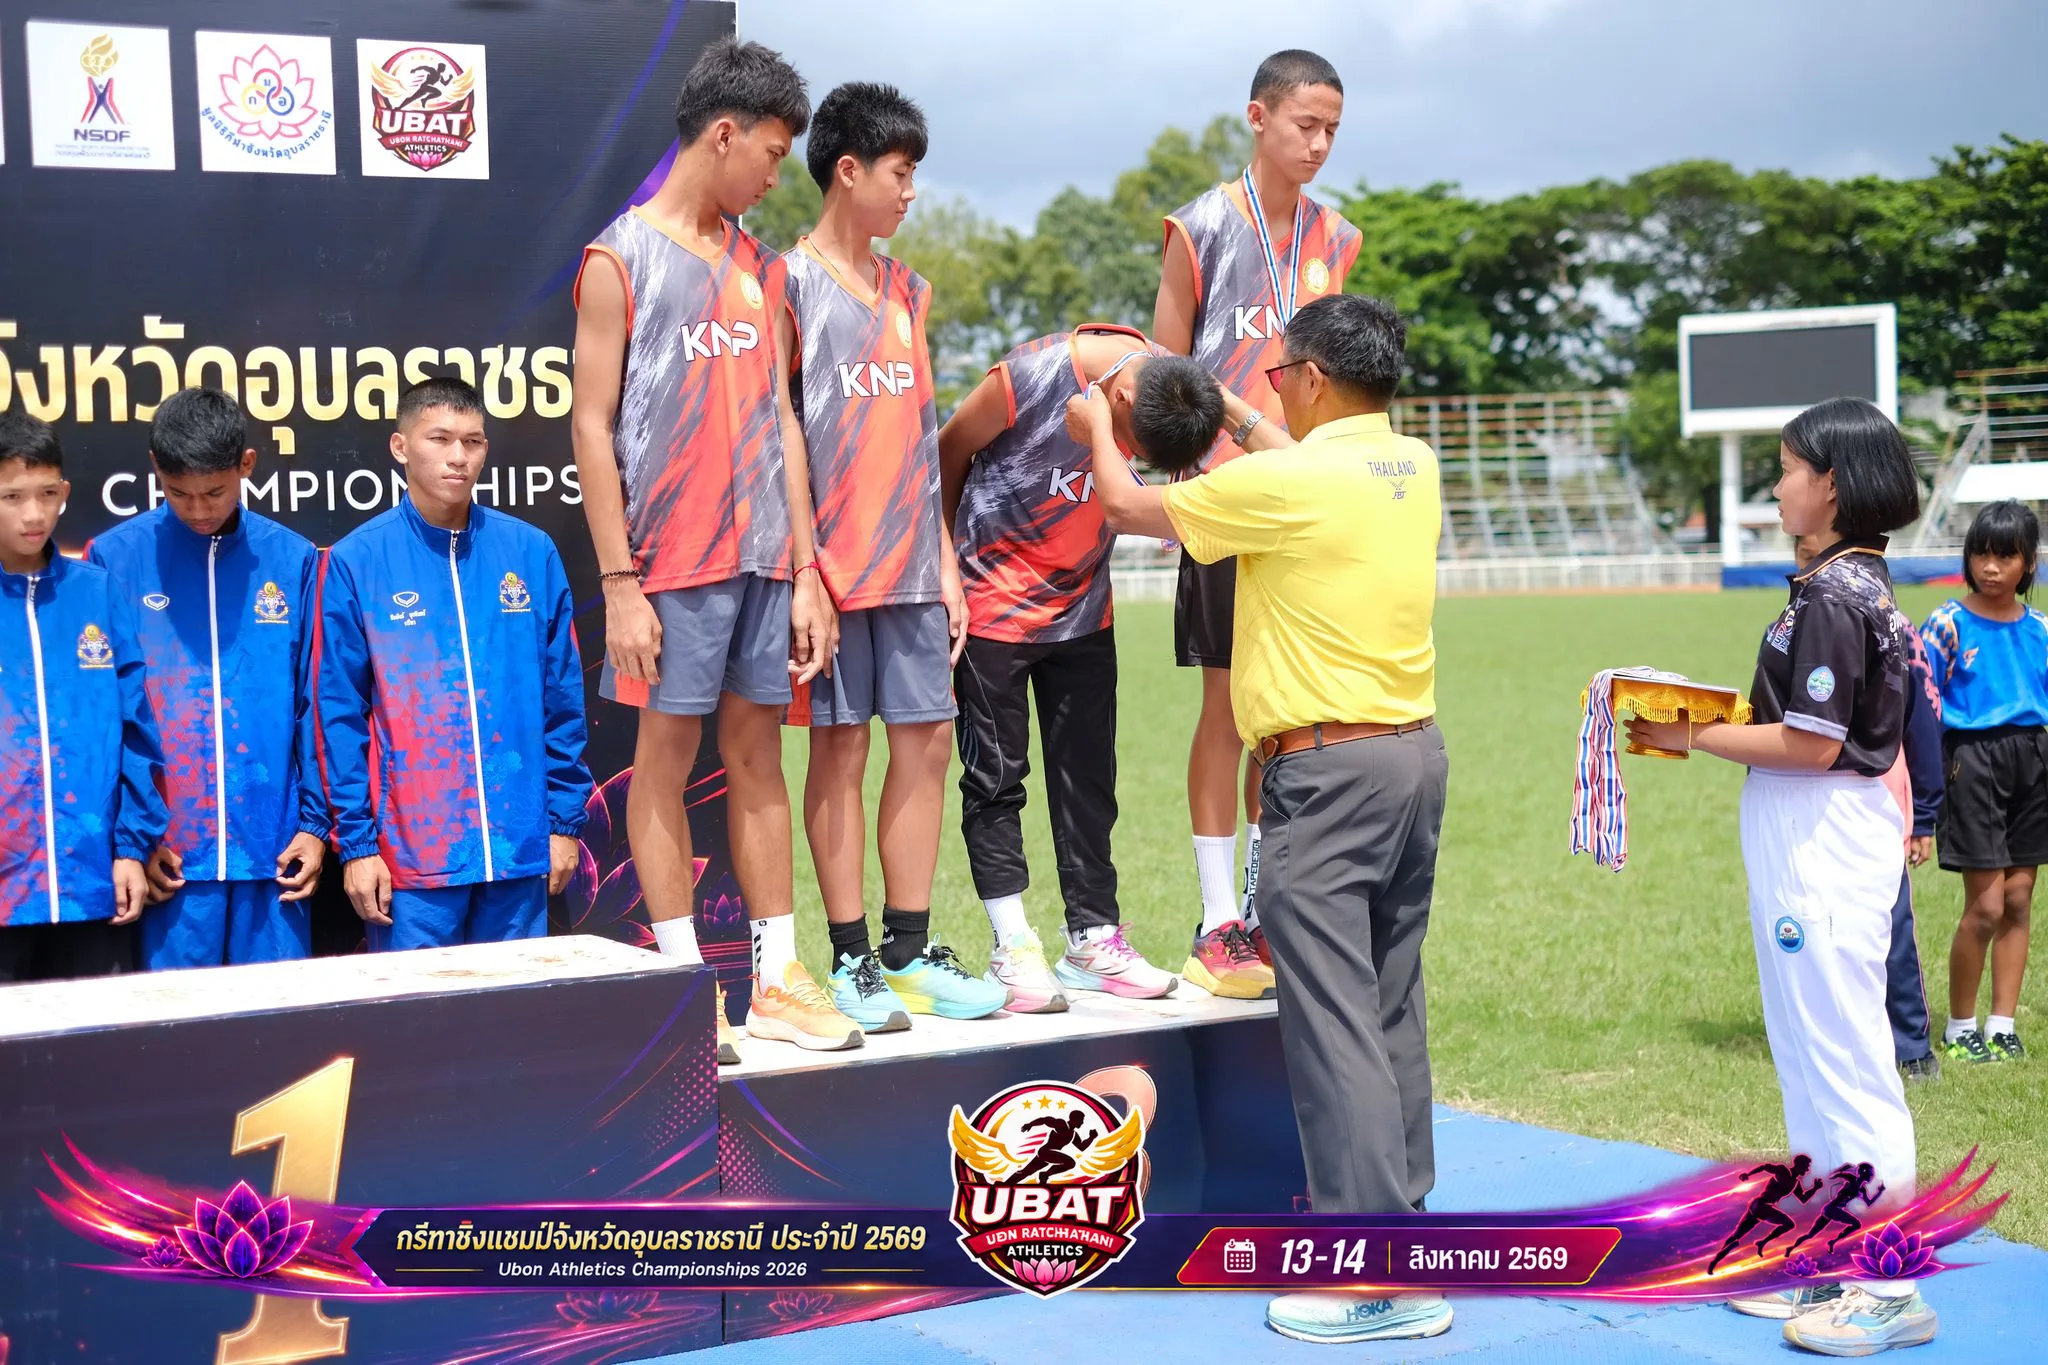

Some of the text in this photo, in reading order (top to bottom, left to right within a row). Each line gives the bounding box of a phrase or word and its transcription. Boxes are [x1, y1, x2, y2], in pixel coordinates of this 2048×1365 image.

[73, 128, 131, 142] NSDF
[381, 109, 468, 136] UBAT
[389, 135, 411, 145] UBON
[404, 144, 447, 152] ATHLETICS
[1233, 304, 1303, 341] KN
[680, 319, 760, 362] KNP
[838, 361, 915, 399] KNP
[1367, 460, 1416, 477] THAILAND
[1346, 1299, 1393, 1324] HOKA
